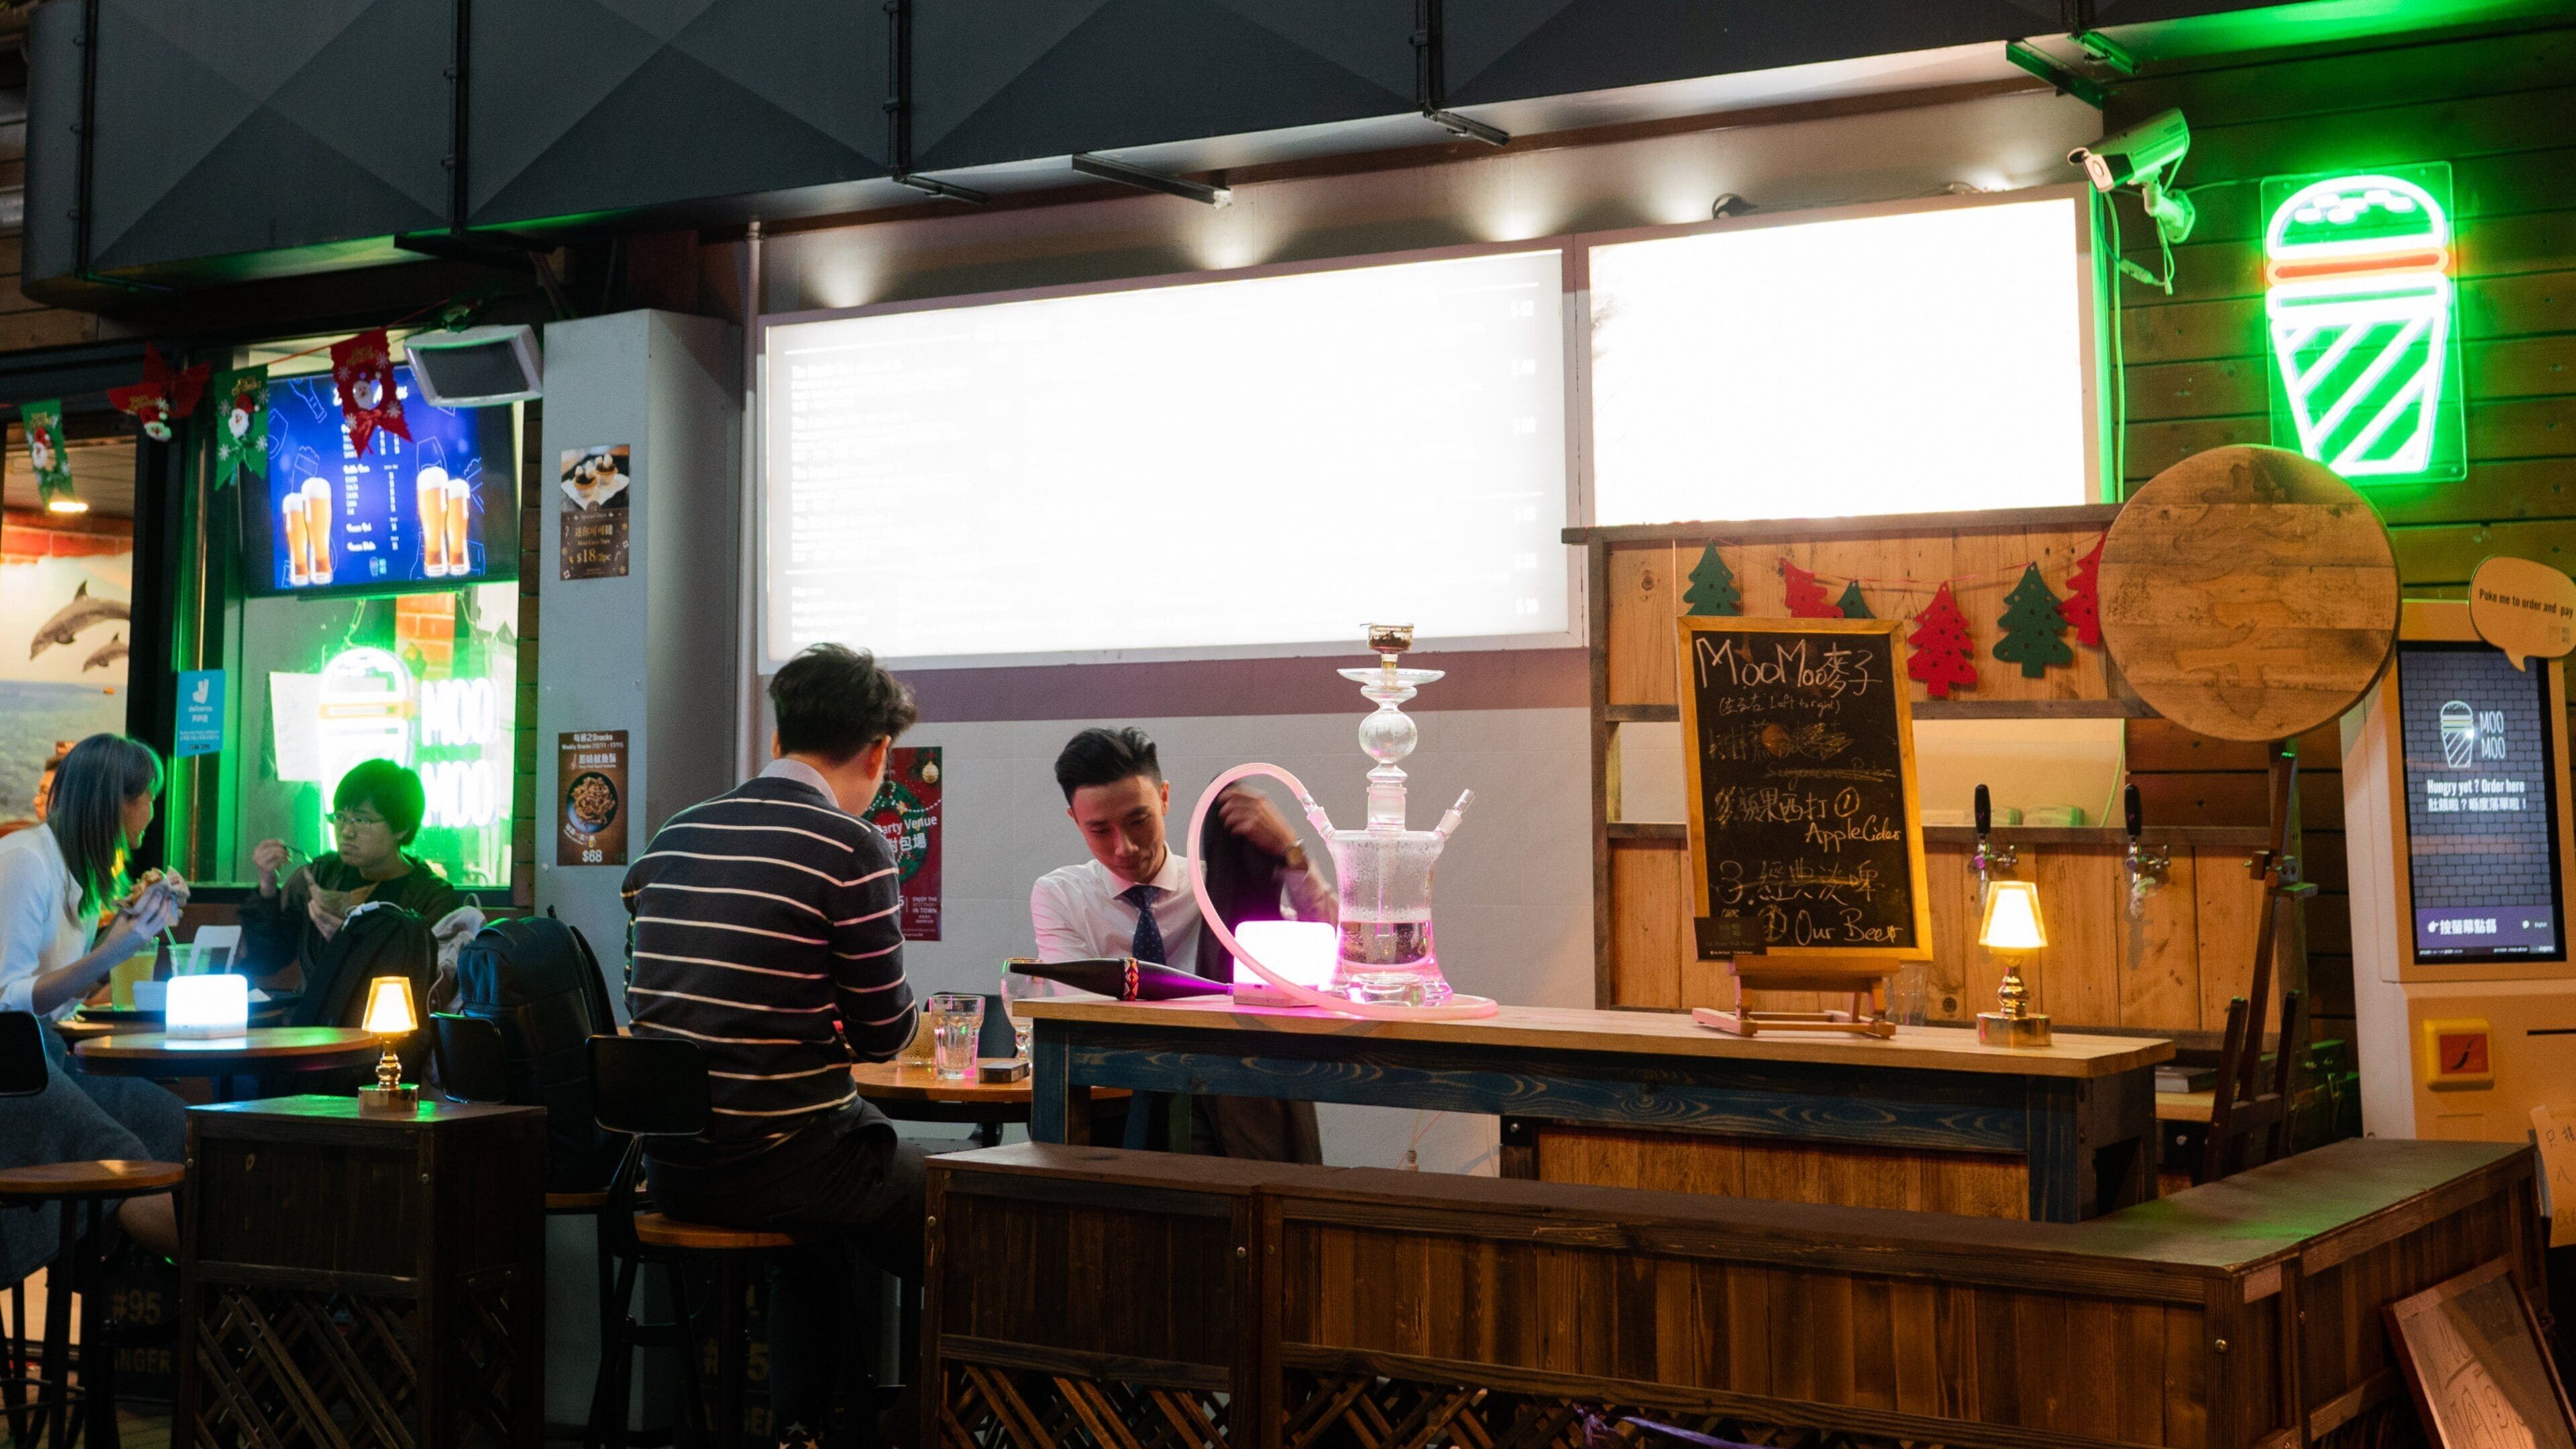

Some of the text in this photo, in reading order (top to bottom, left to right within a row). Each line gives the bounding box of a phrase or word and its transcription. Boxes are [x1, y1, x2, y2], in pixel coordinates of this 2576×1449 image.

[2479, 588, 2573, 619] Poke me to order and pay
[421, 676, 497, 746] MOO
[2479, 711, 2504, 734] MOO
[2481, 737, 2506, 759] MOO
[421, 759, 496, 828] MOO
[2427, 779, 2457, 796] Hungry
[2458, 780, 2473, 796] yet
[2481, 778, 2504, 793] Order
[2506, 778, 2524, 793] here
[904, 816, 938, 830] Venue
[582, 849, 602, 863] $68
